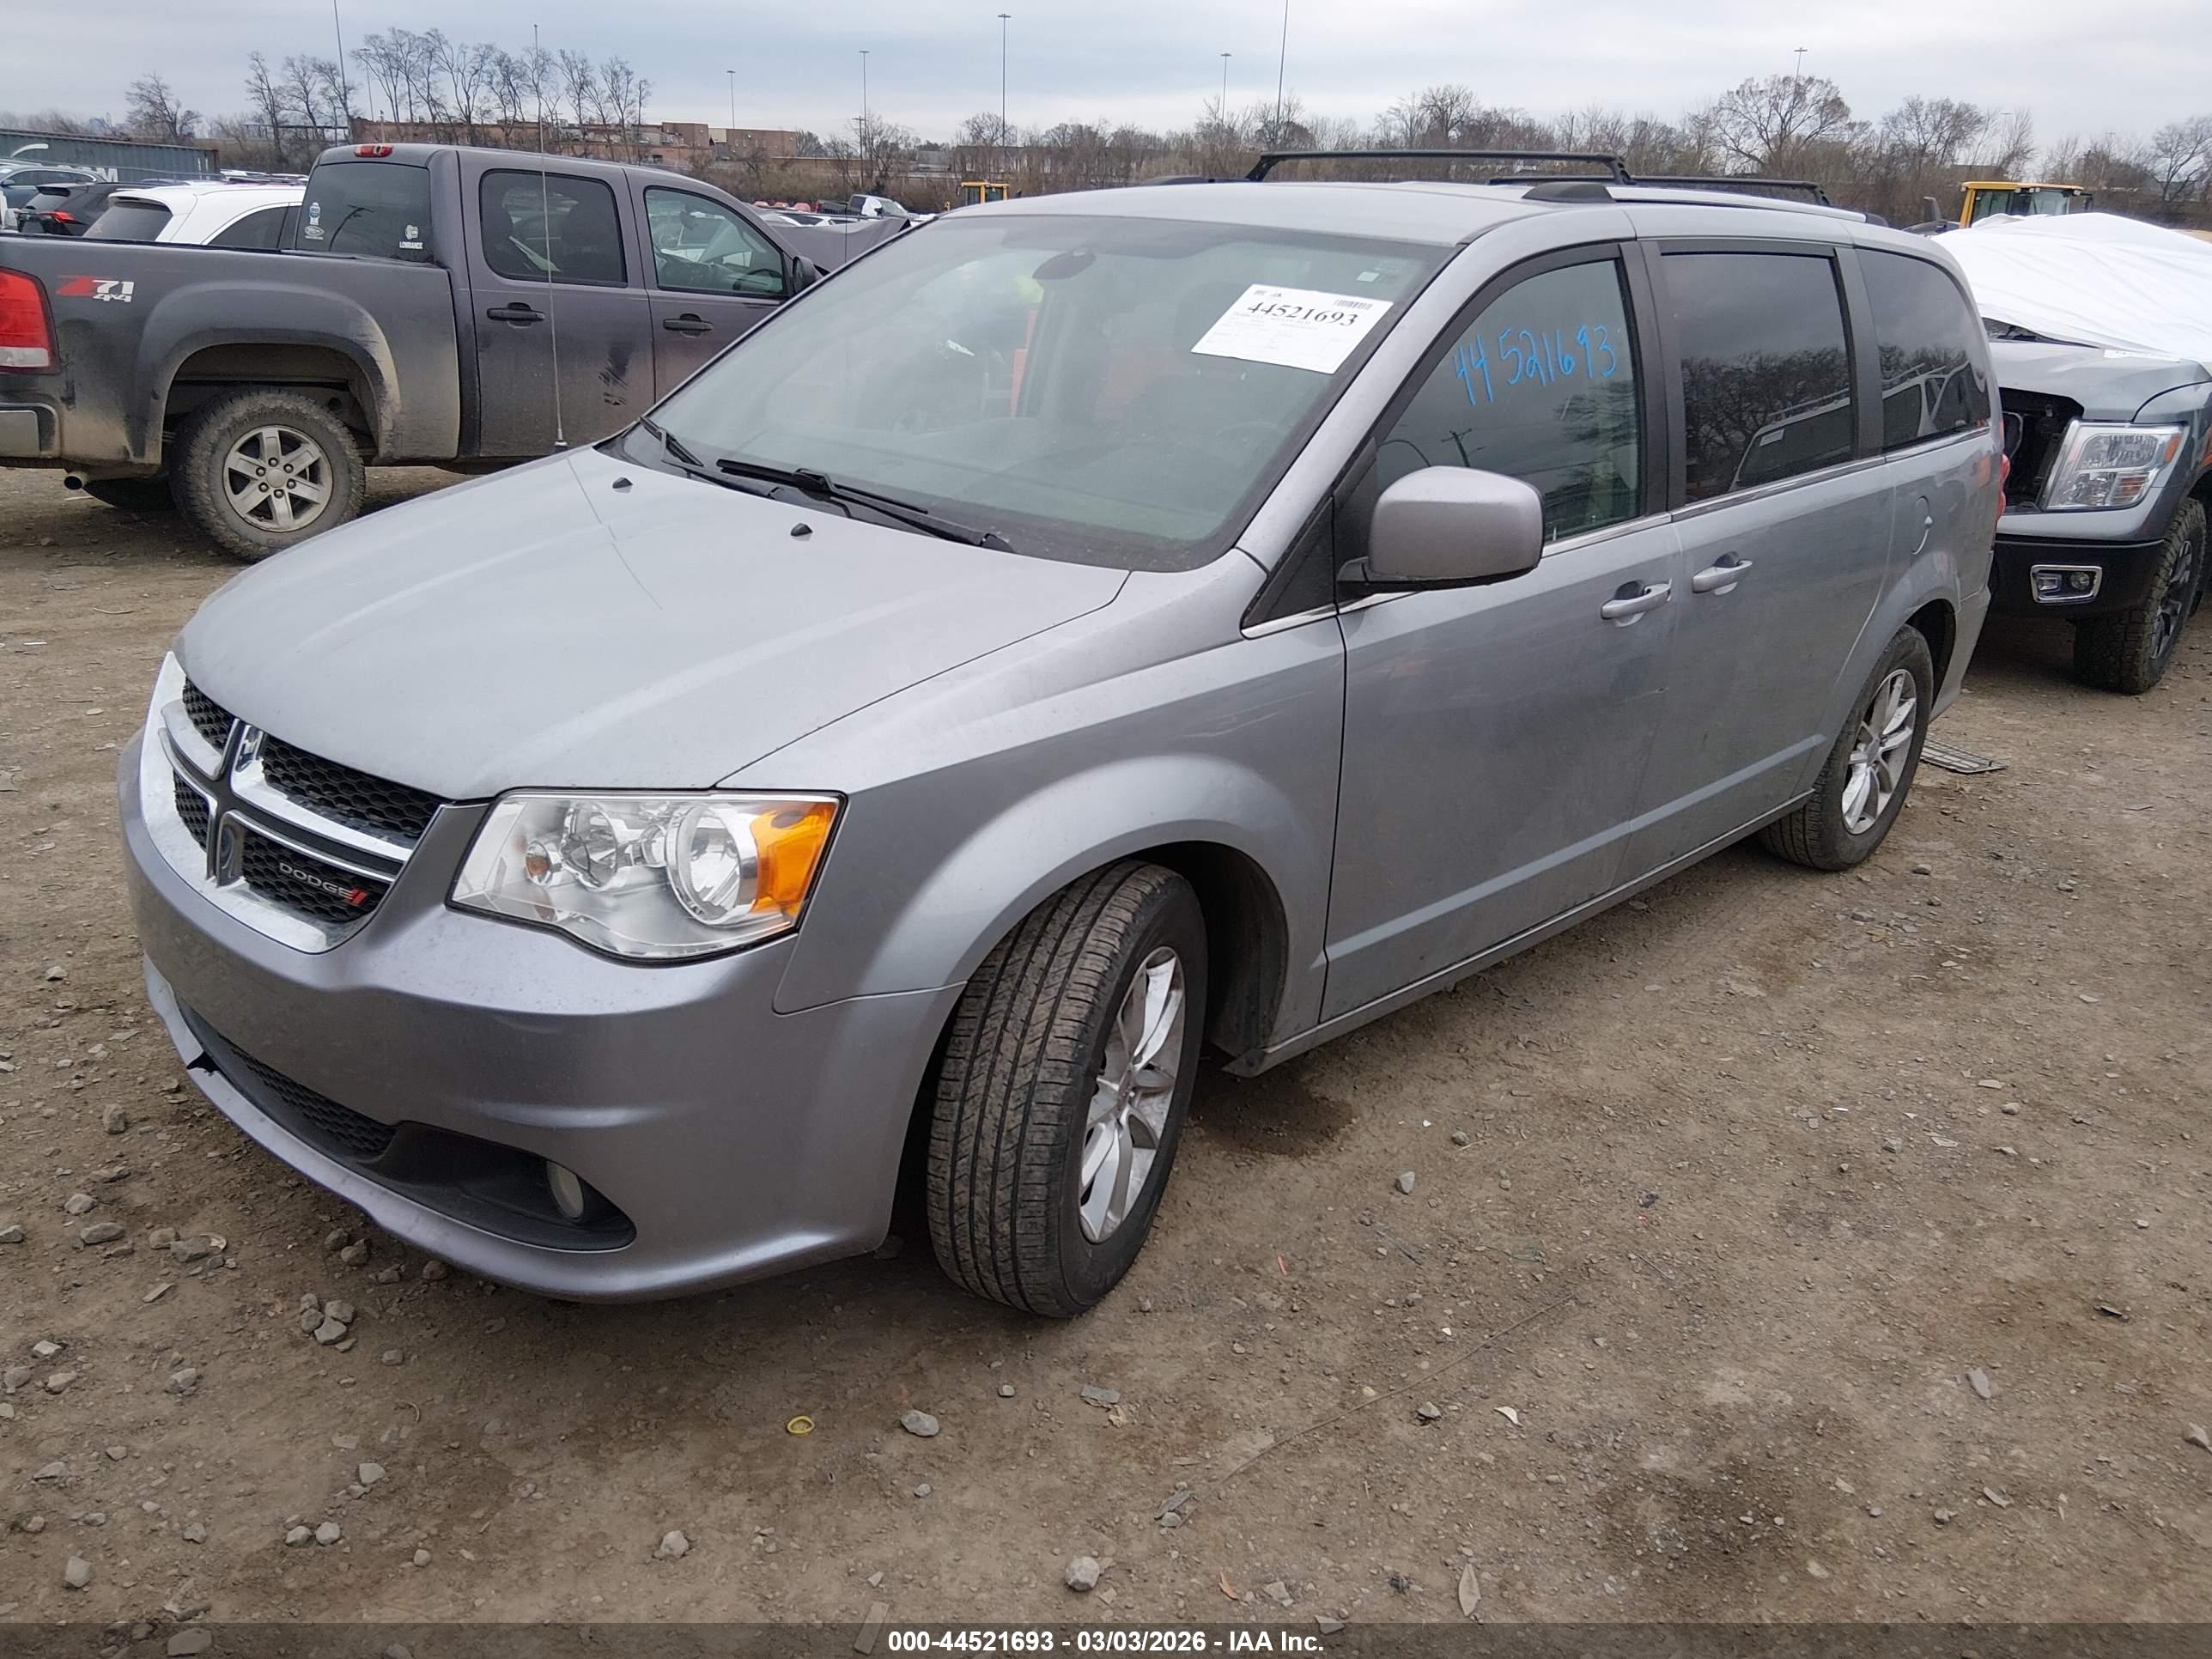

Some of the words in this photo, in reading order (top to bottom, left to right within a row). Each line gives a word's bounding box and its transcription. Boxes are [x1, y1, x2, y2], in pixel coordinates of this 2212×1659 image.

[56, 275, 135, 298] Z71
[1247, 301, 1358, 327] 44521693
[279, 862, 354, 901] DODGE
